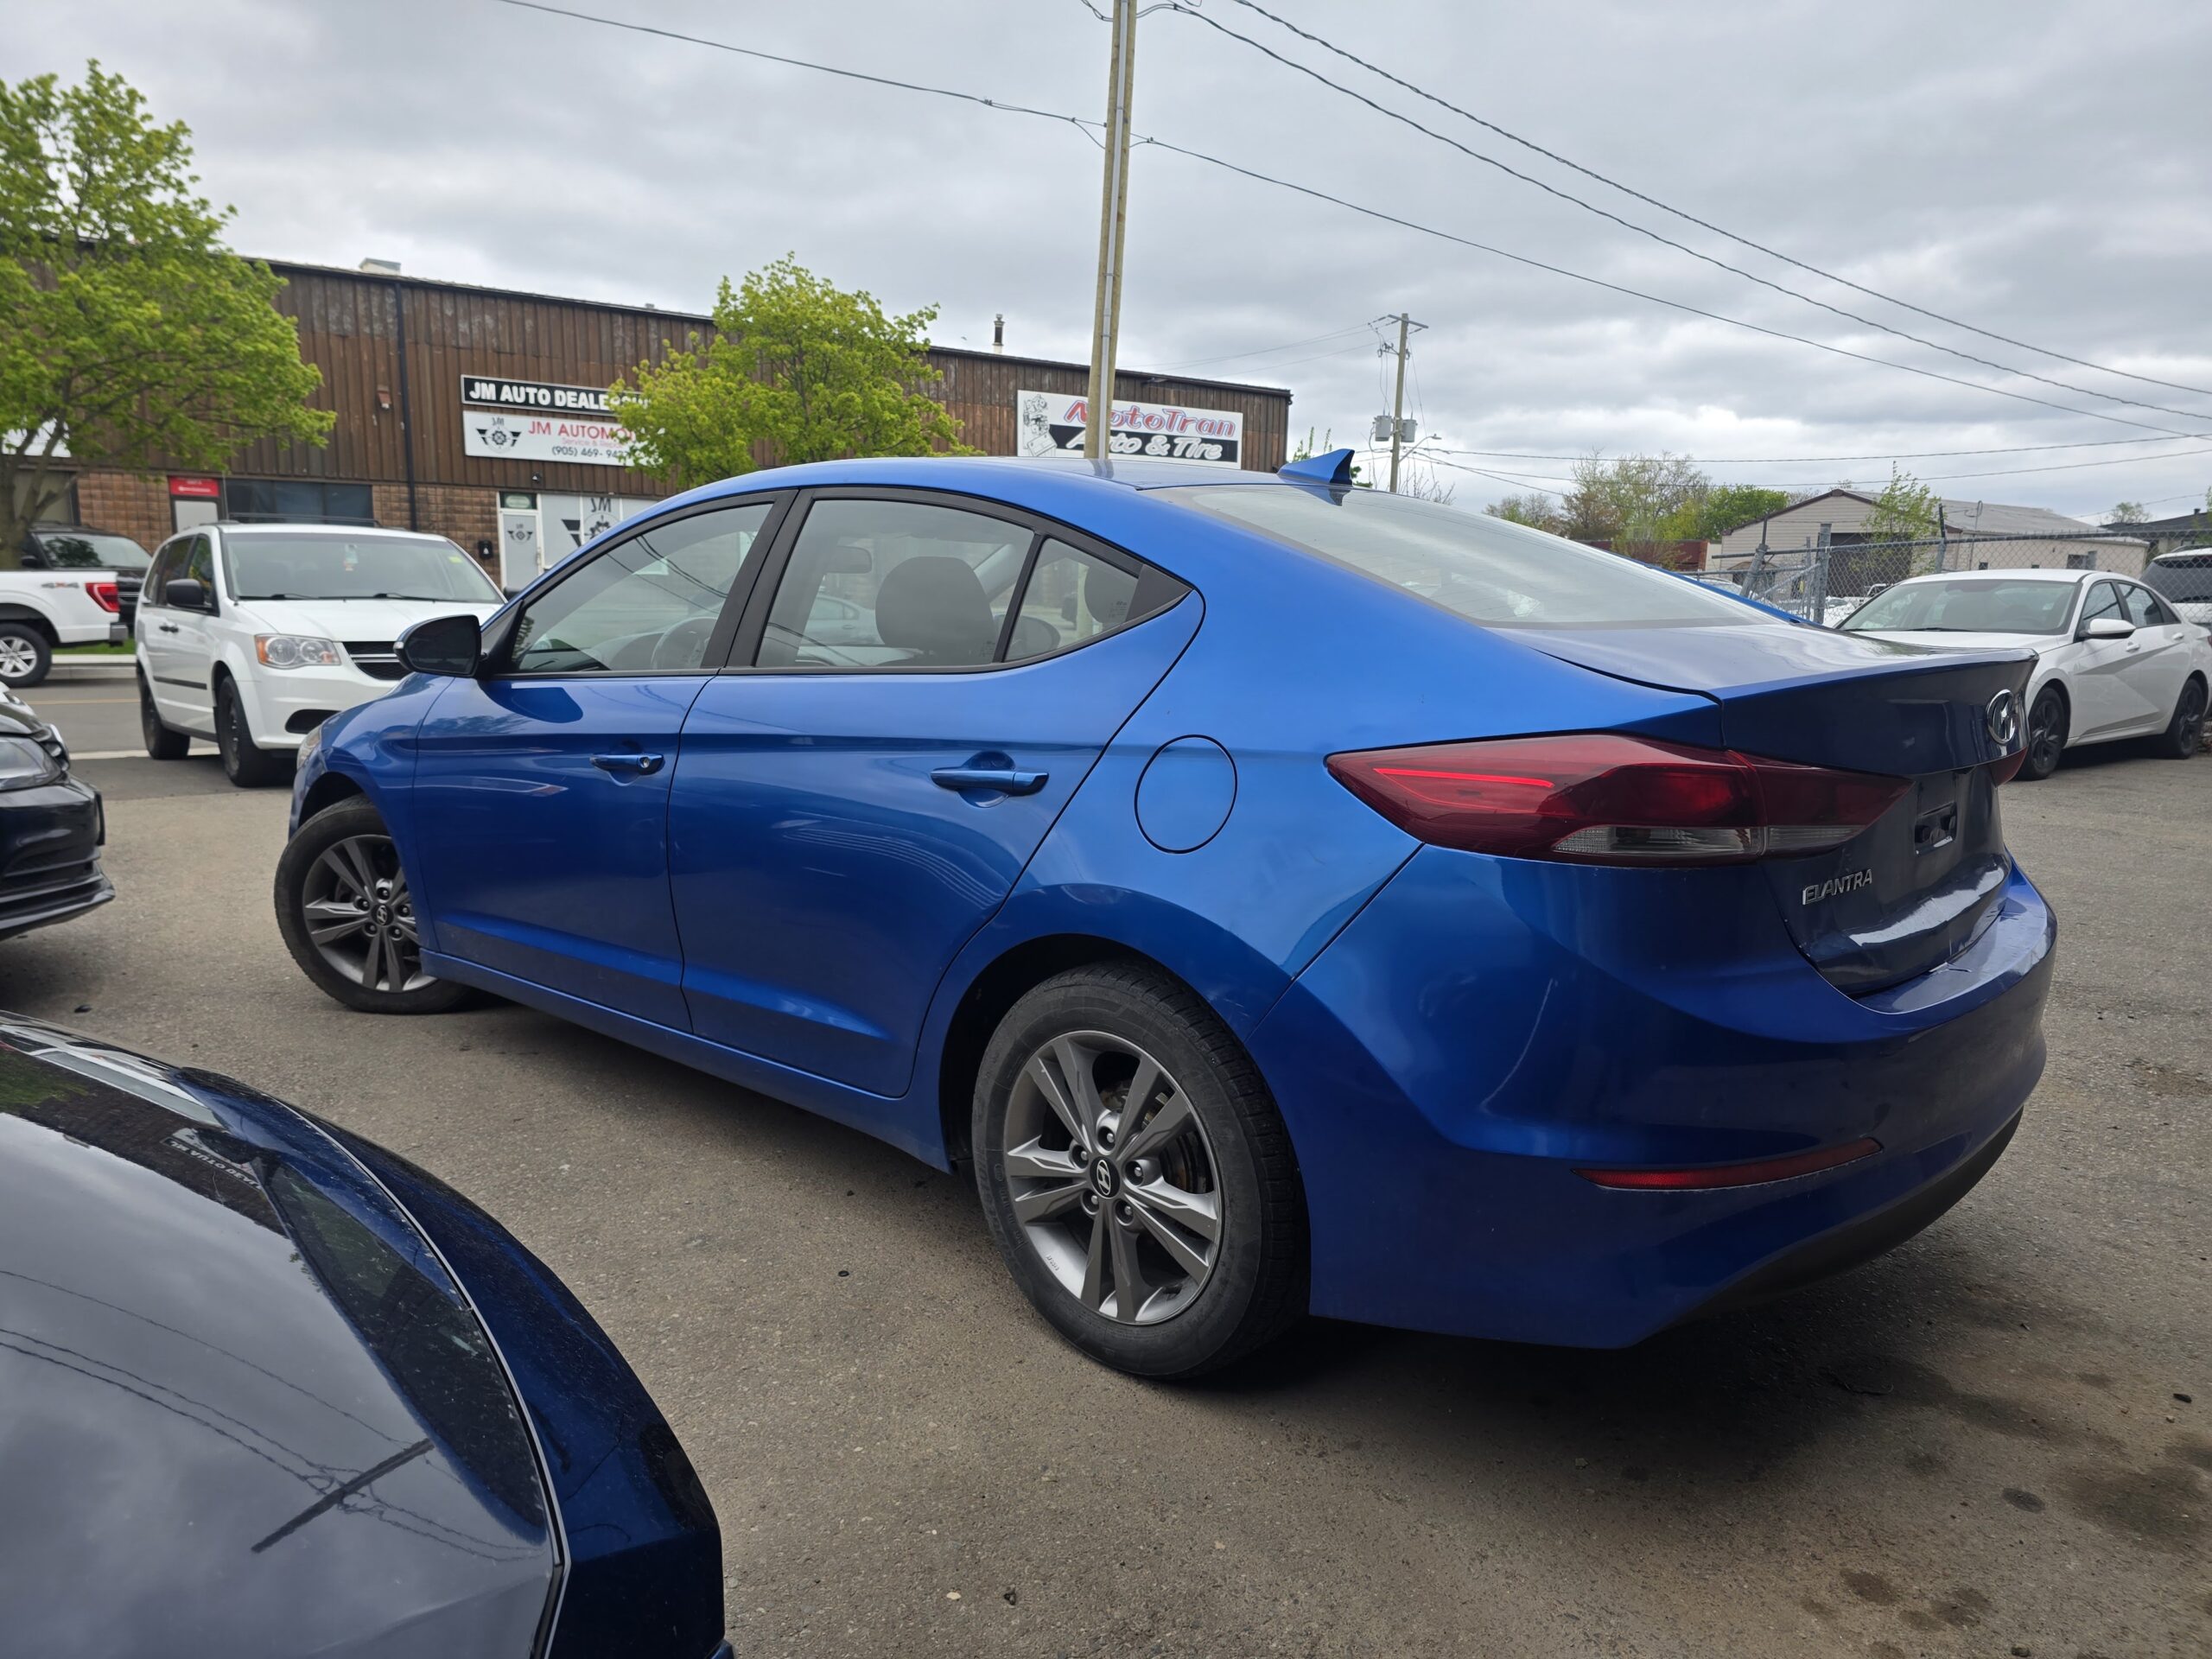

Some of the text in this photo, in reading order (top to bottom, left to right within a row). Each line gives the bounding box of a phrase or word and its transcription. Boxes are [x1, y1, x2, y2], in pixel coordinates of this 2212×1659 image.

[469, 381, 496, 401] JM
[499, 385, 551, 406] AUTO
[529, 421, 551, 435] JM
[551, 446, 578, 457] (905)
[1065, 429, 1224, 460] Ato & Tire
[1802, 868, 1872, 906] ELANTRA
